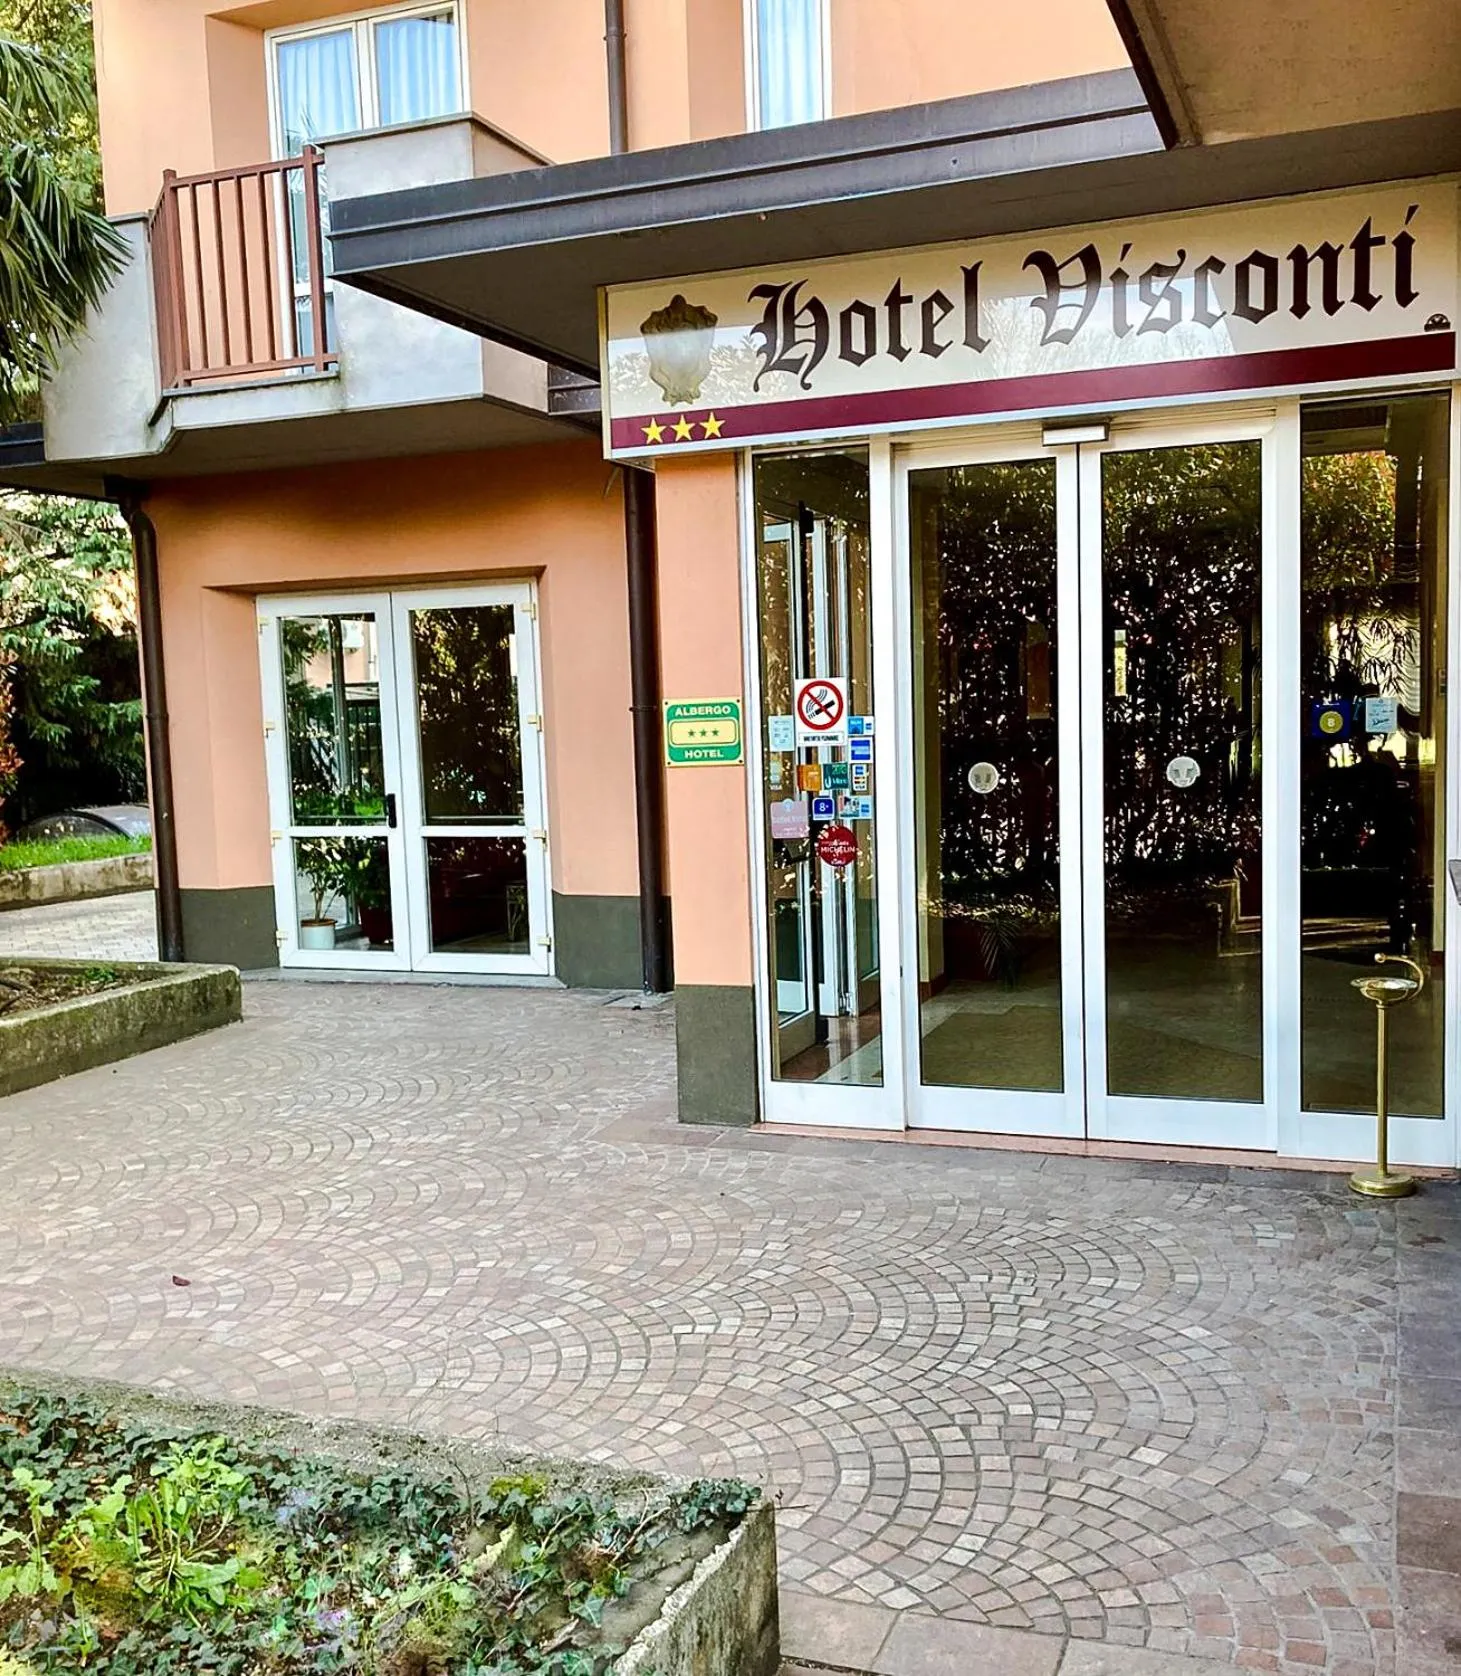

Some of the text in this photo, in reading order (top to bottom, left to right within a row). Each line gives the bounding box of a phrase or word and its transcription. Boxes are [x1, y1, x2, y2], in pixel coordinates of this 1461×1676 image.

[748, 204, 1420, 392] Hotel Visconti
[675, 705, 731, 716] ALBERGO
[684, 749, 724, 759] HOTEL
